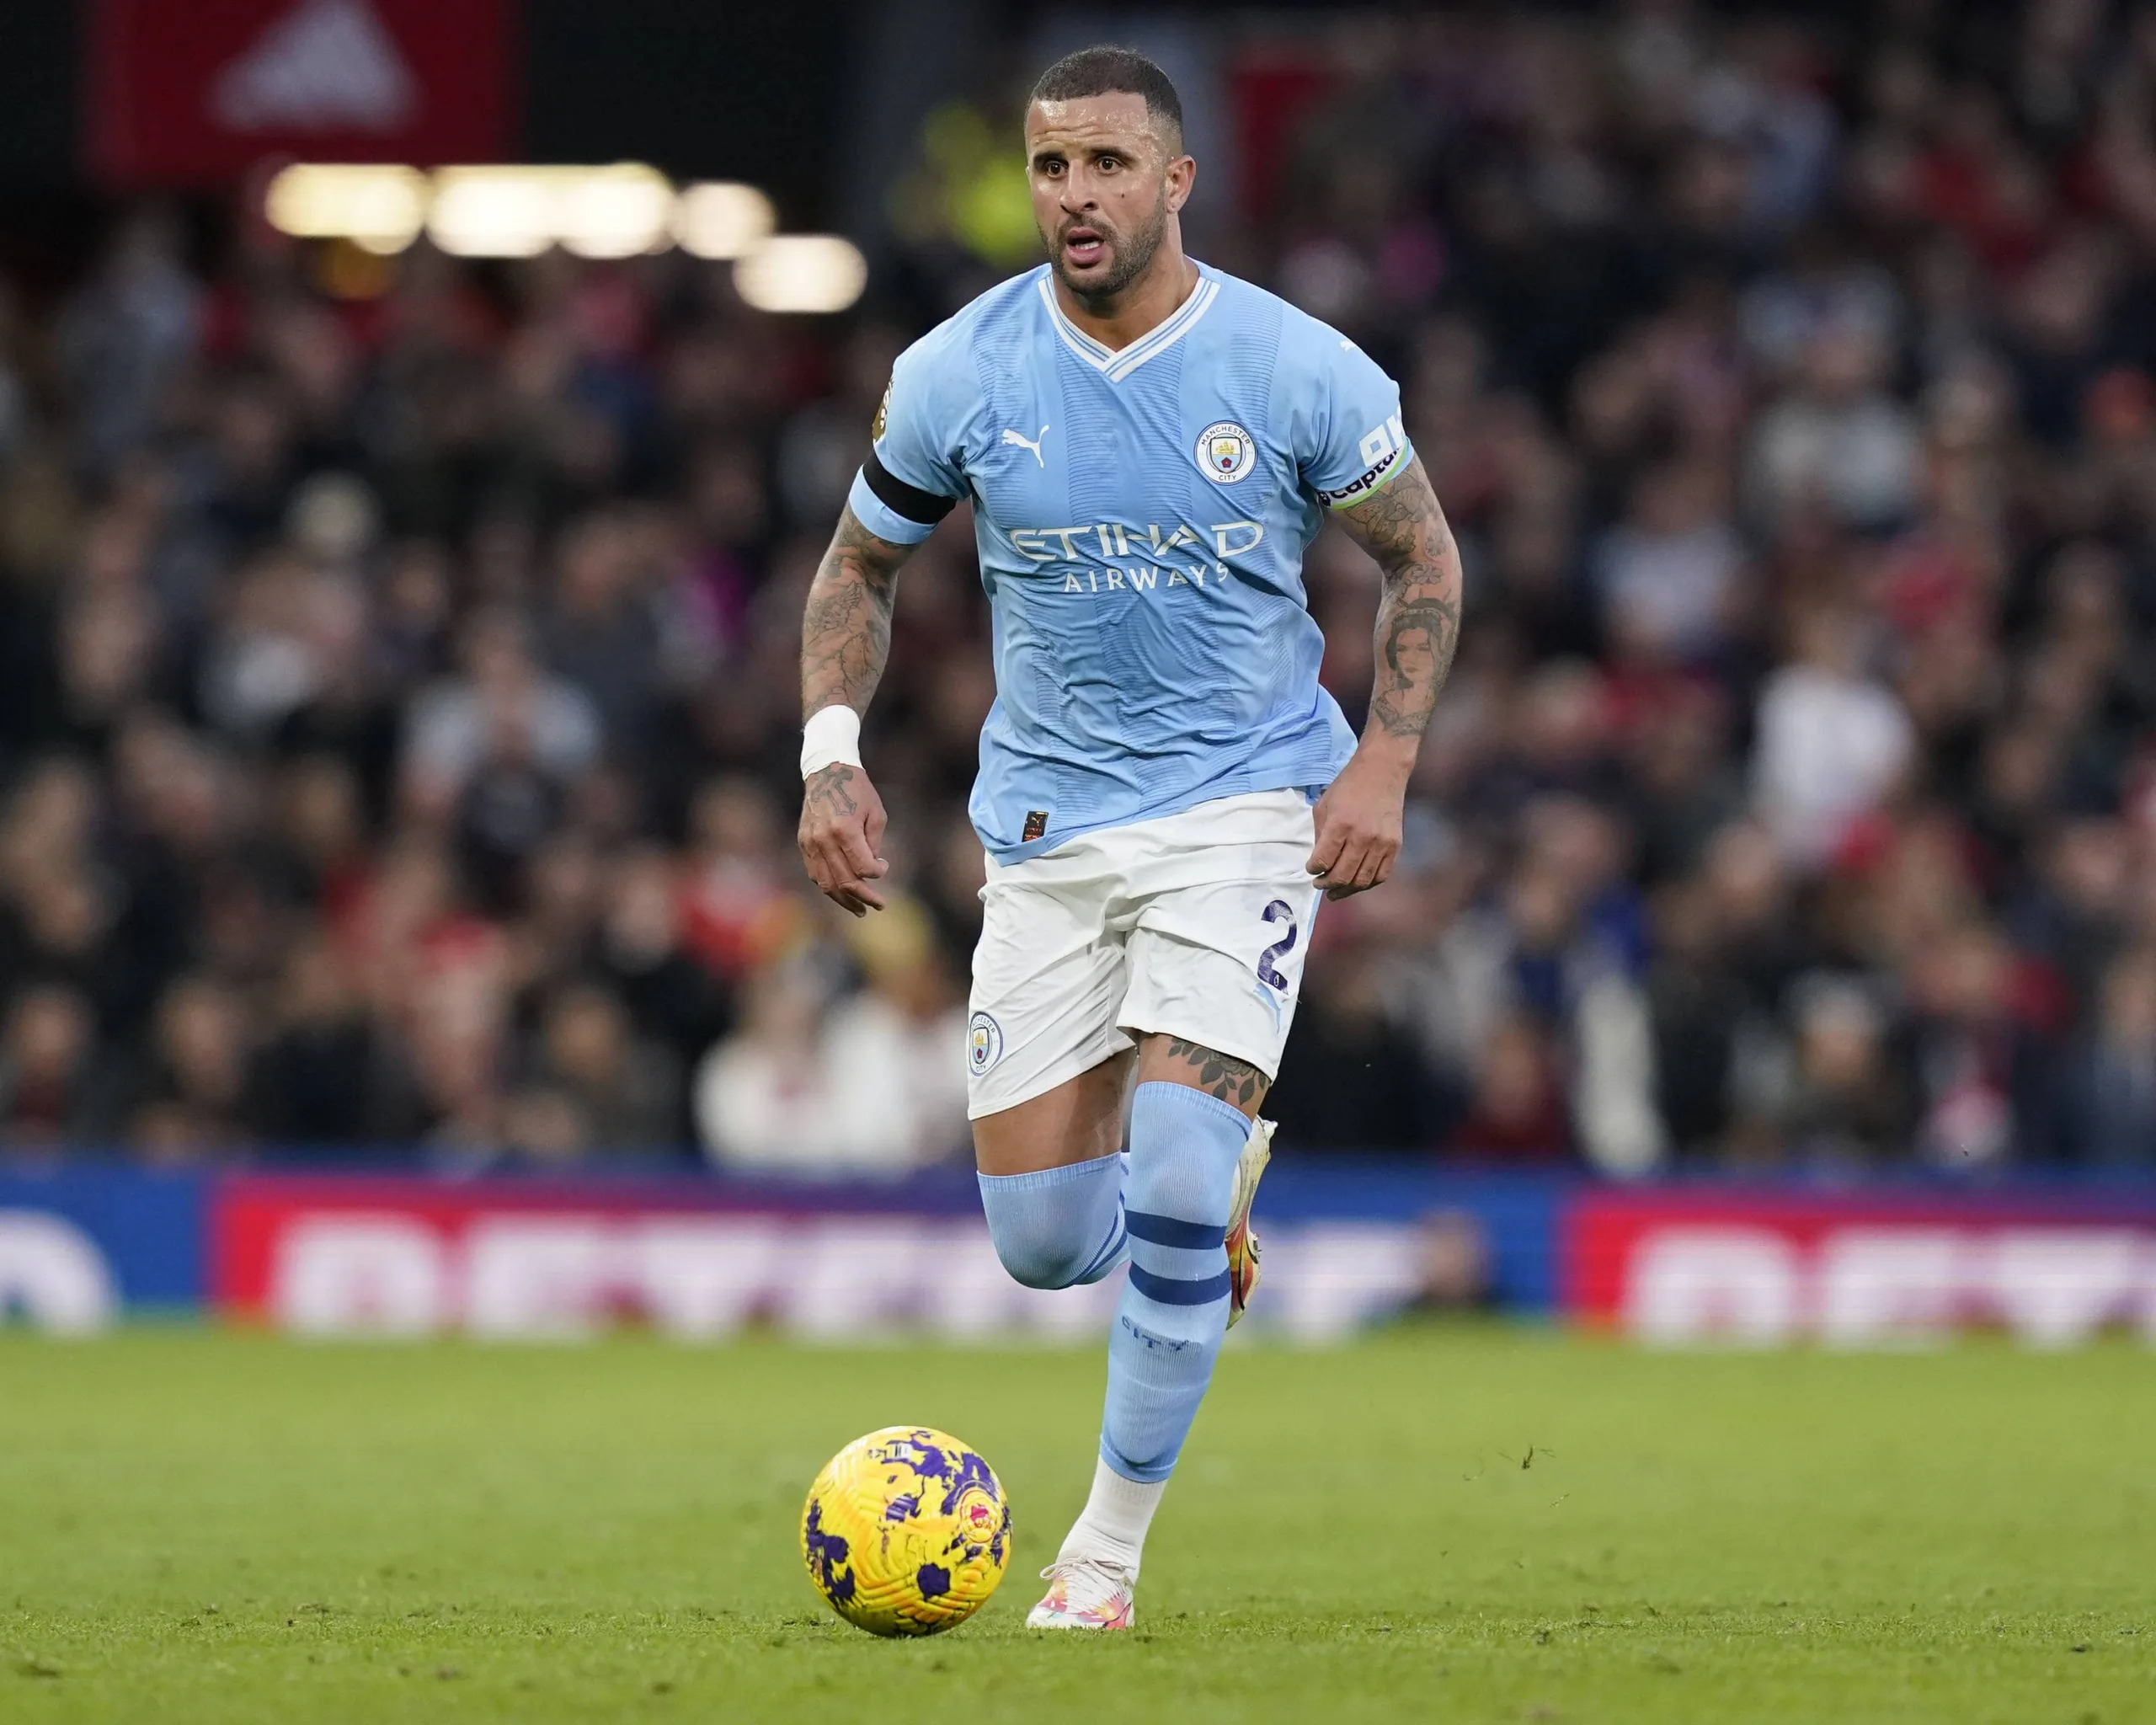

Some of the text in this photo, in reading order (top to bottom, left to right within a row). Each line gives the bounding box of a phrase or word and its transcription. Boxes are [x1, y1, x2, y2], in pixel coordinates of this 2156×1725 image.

[1201, 425, 1251, 446] MANCHESTER
[1331, 446, 1400, 499] capta
[1010, 521, 1264, 561] ETIHAD
[1065, 563, 1230, 593] AIRWAYS
[1257, 900, 1298, 995] 2
